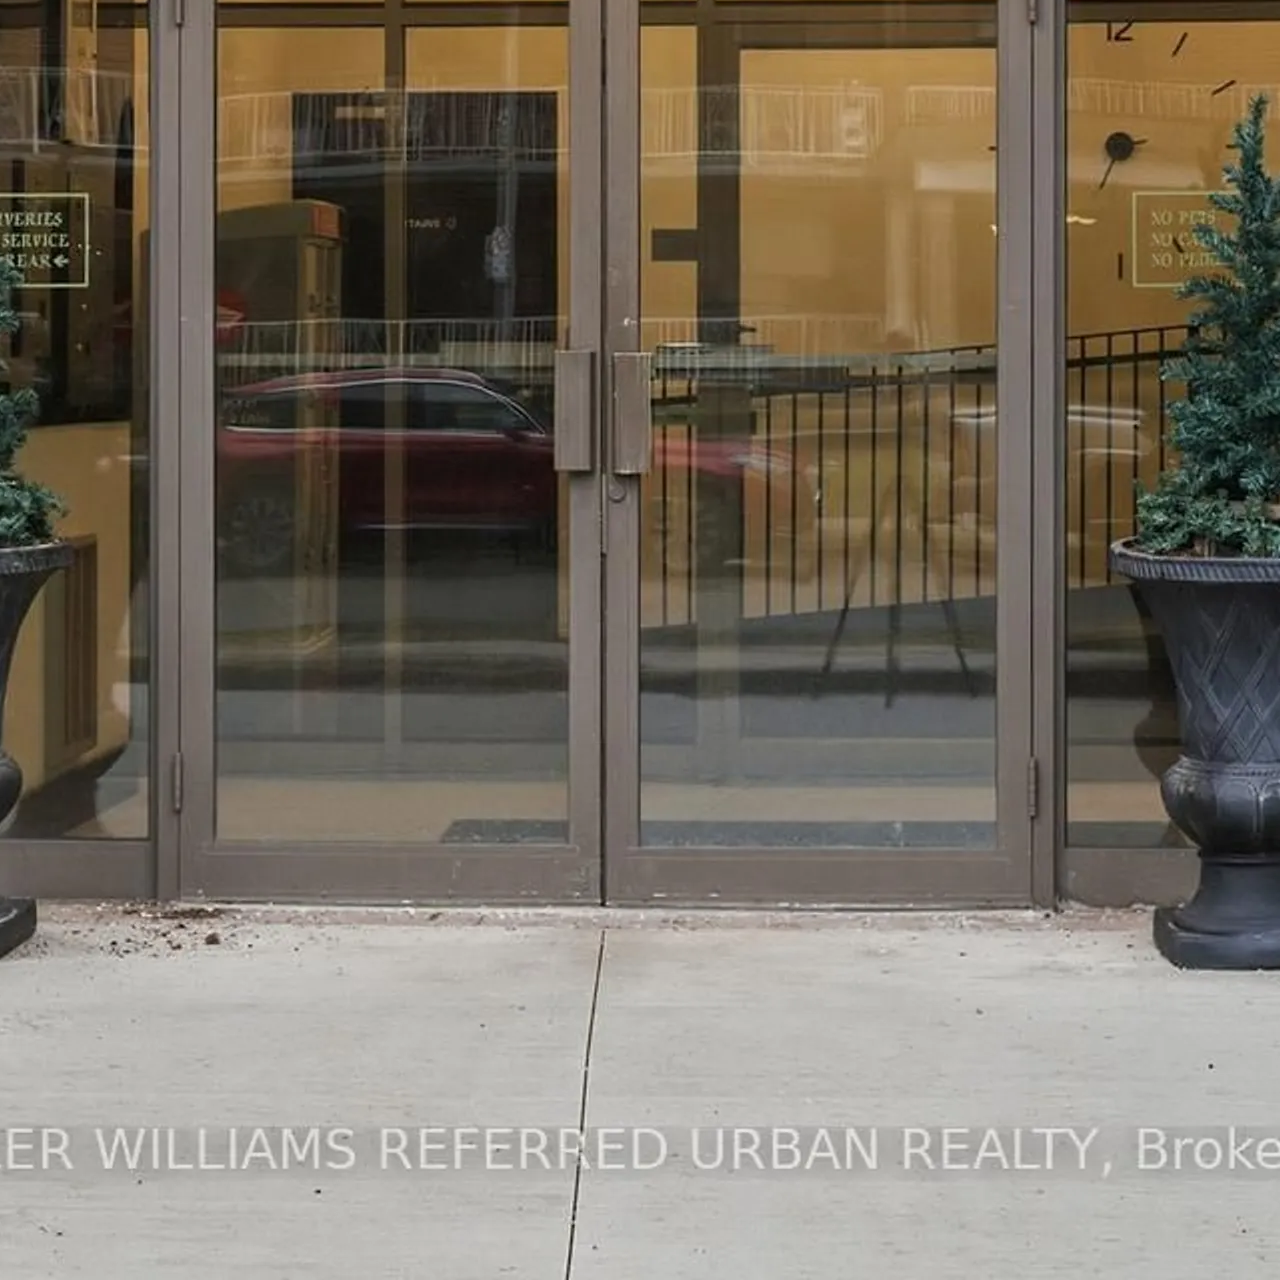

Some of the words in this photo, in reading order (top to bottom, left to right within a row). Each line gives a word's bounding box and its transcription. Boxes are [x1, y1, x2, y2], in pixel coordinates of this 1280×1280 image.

[1151, 210, 1173, 226] NO
[1, 233, 70, 248] SERVICE
[1151, 232, 1173, 248] NO
[1151, 252, 1173, 268] NO
